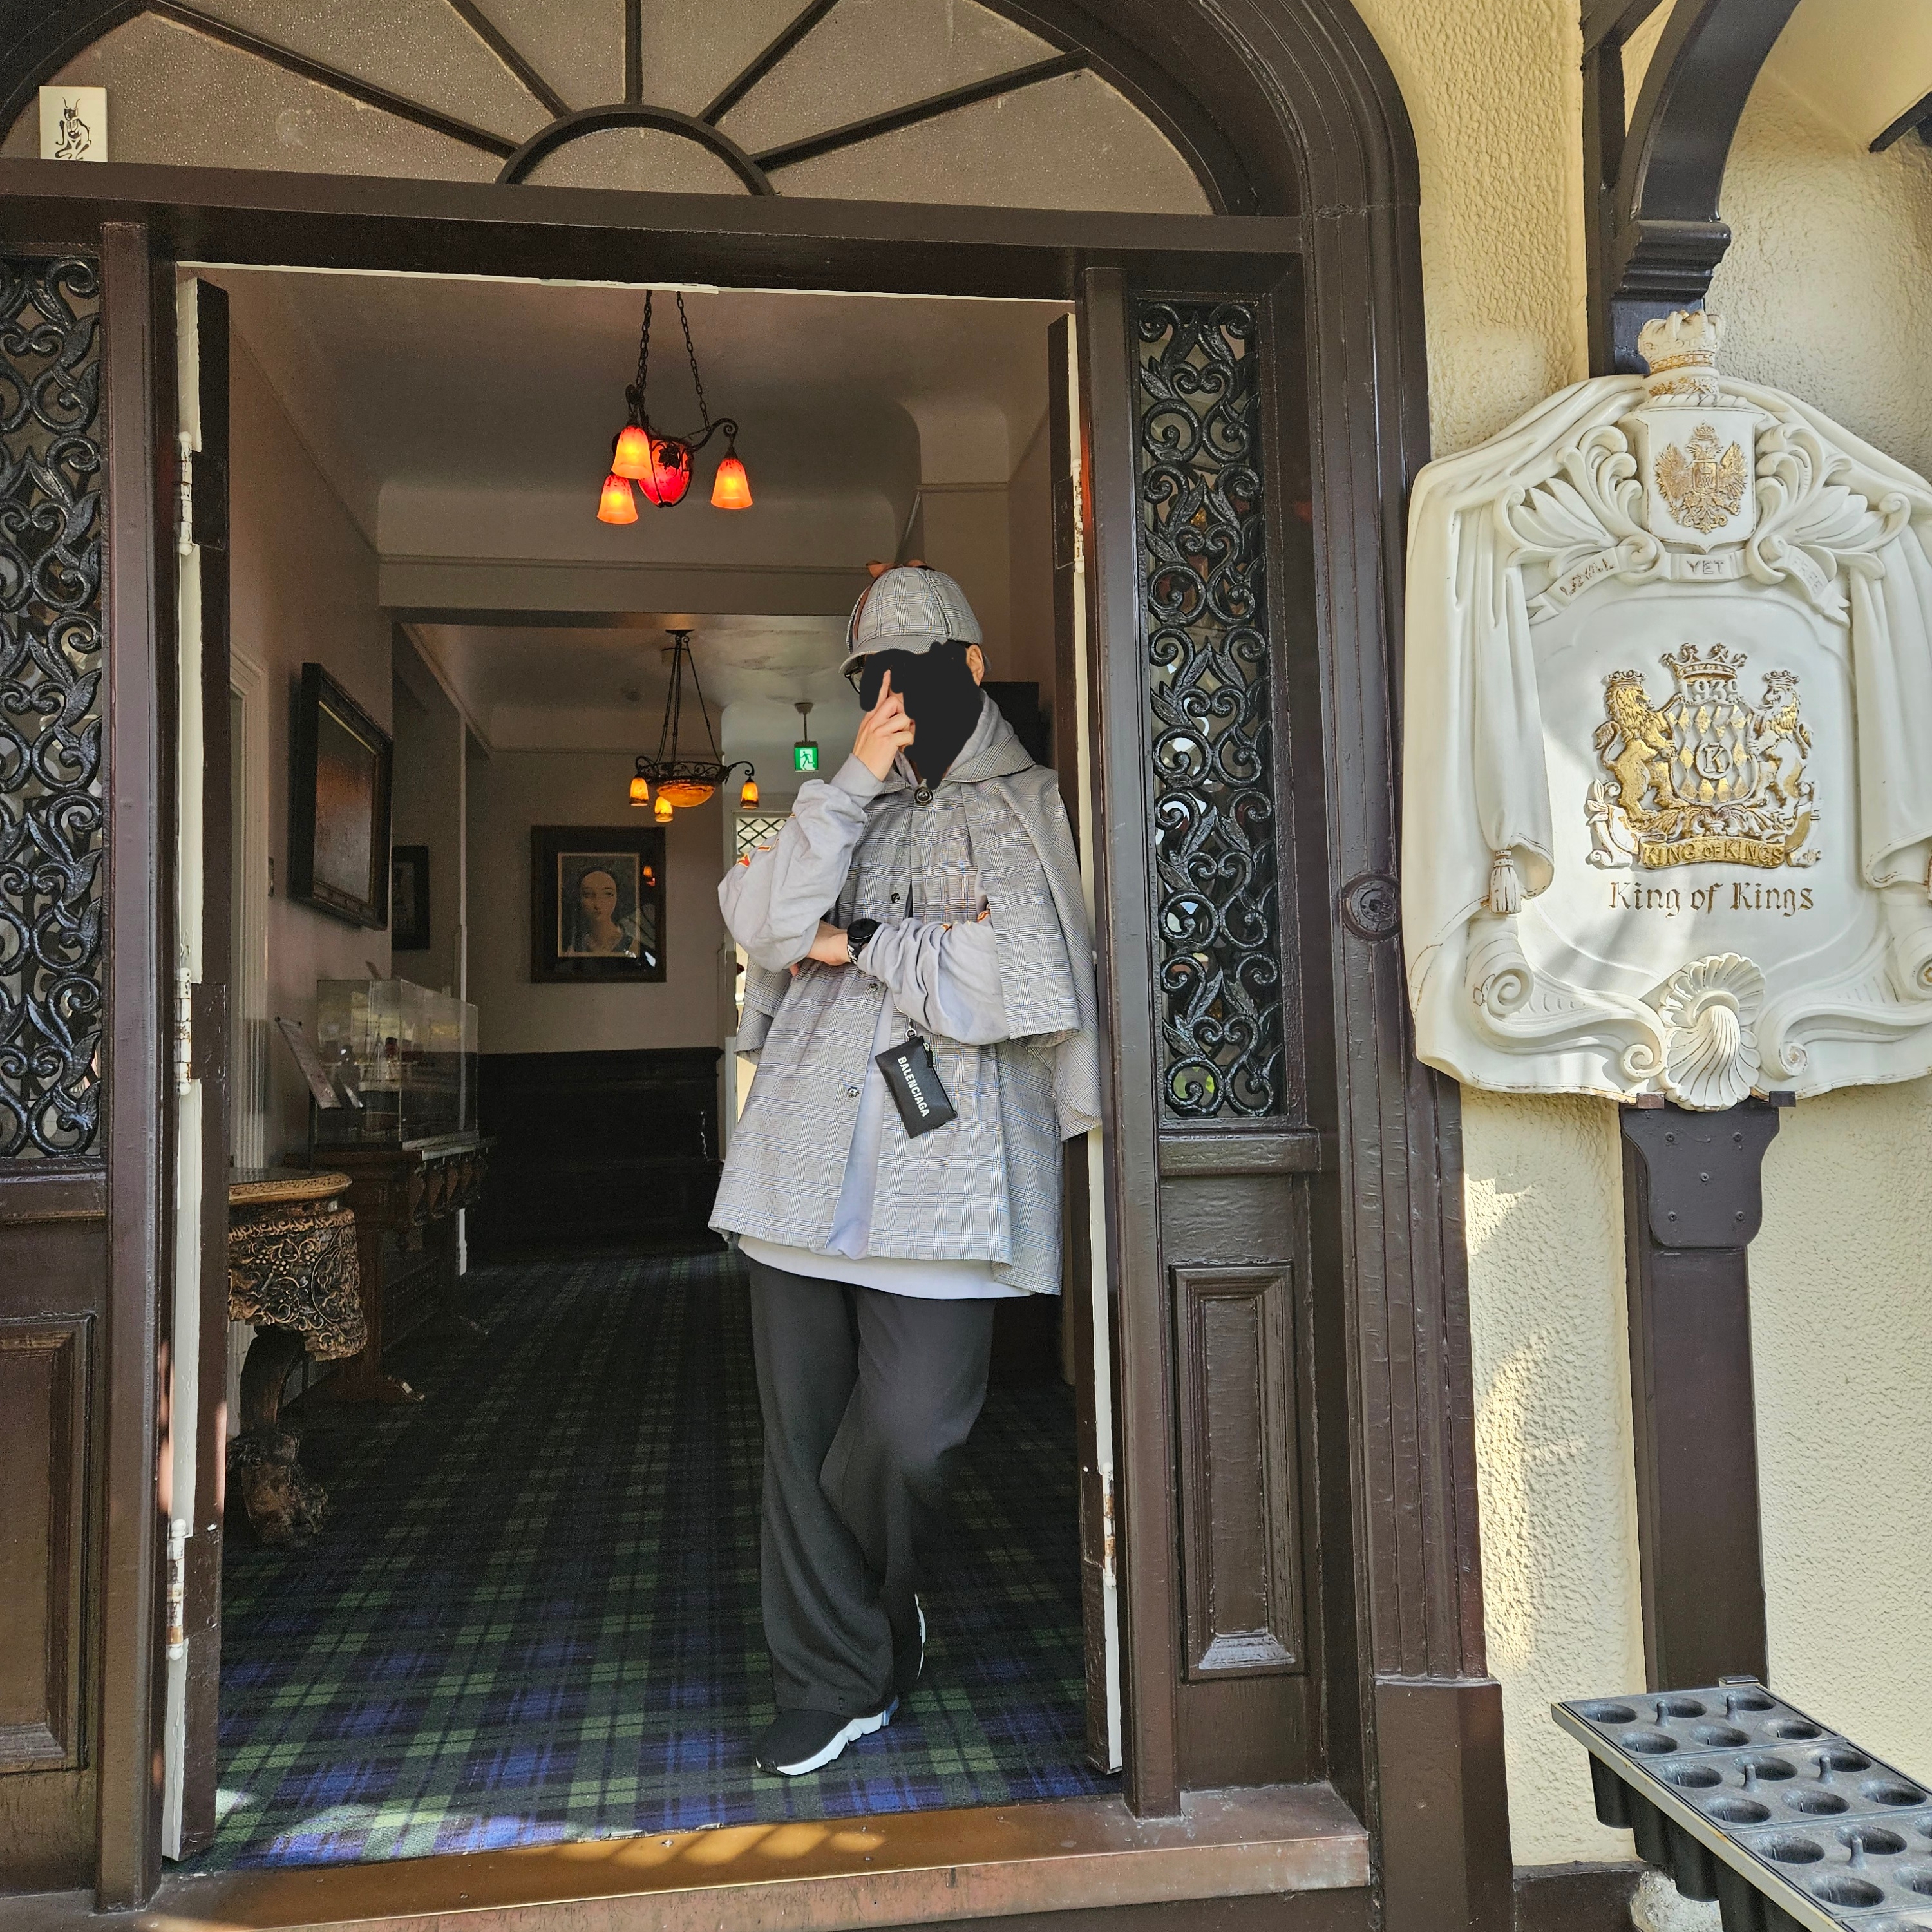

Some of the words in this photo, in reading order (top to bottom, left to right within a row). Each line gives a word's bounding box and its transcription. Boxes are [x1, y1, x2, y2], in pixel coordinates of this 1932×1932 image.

[1686, 560, 1725, 575] YET
[1703, 746, 1726, 773] K
[1644, 842, 1695, 865] KING
[1724, 840, 1785, 865] KINGS
[1608, 882, 1680, 918] King
[1690, 882, 1723, 914] of
[1730, 882, 1814, 918] Kings
[898, 1056, 930, 1118] BALENCIAGA
